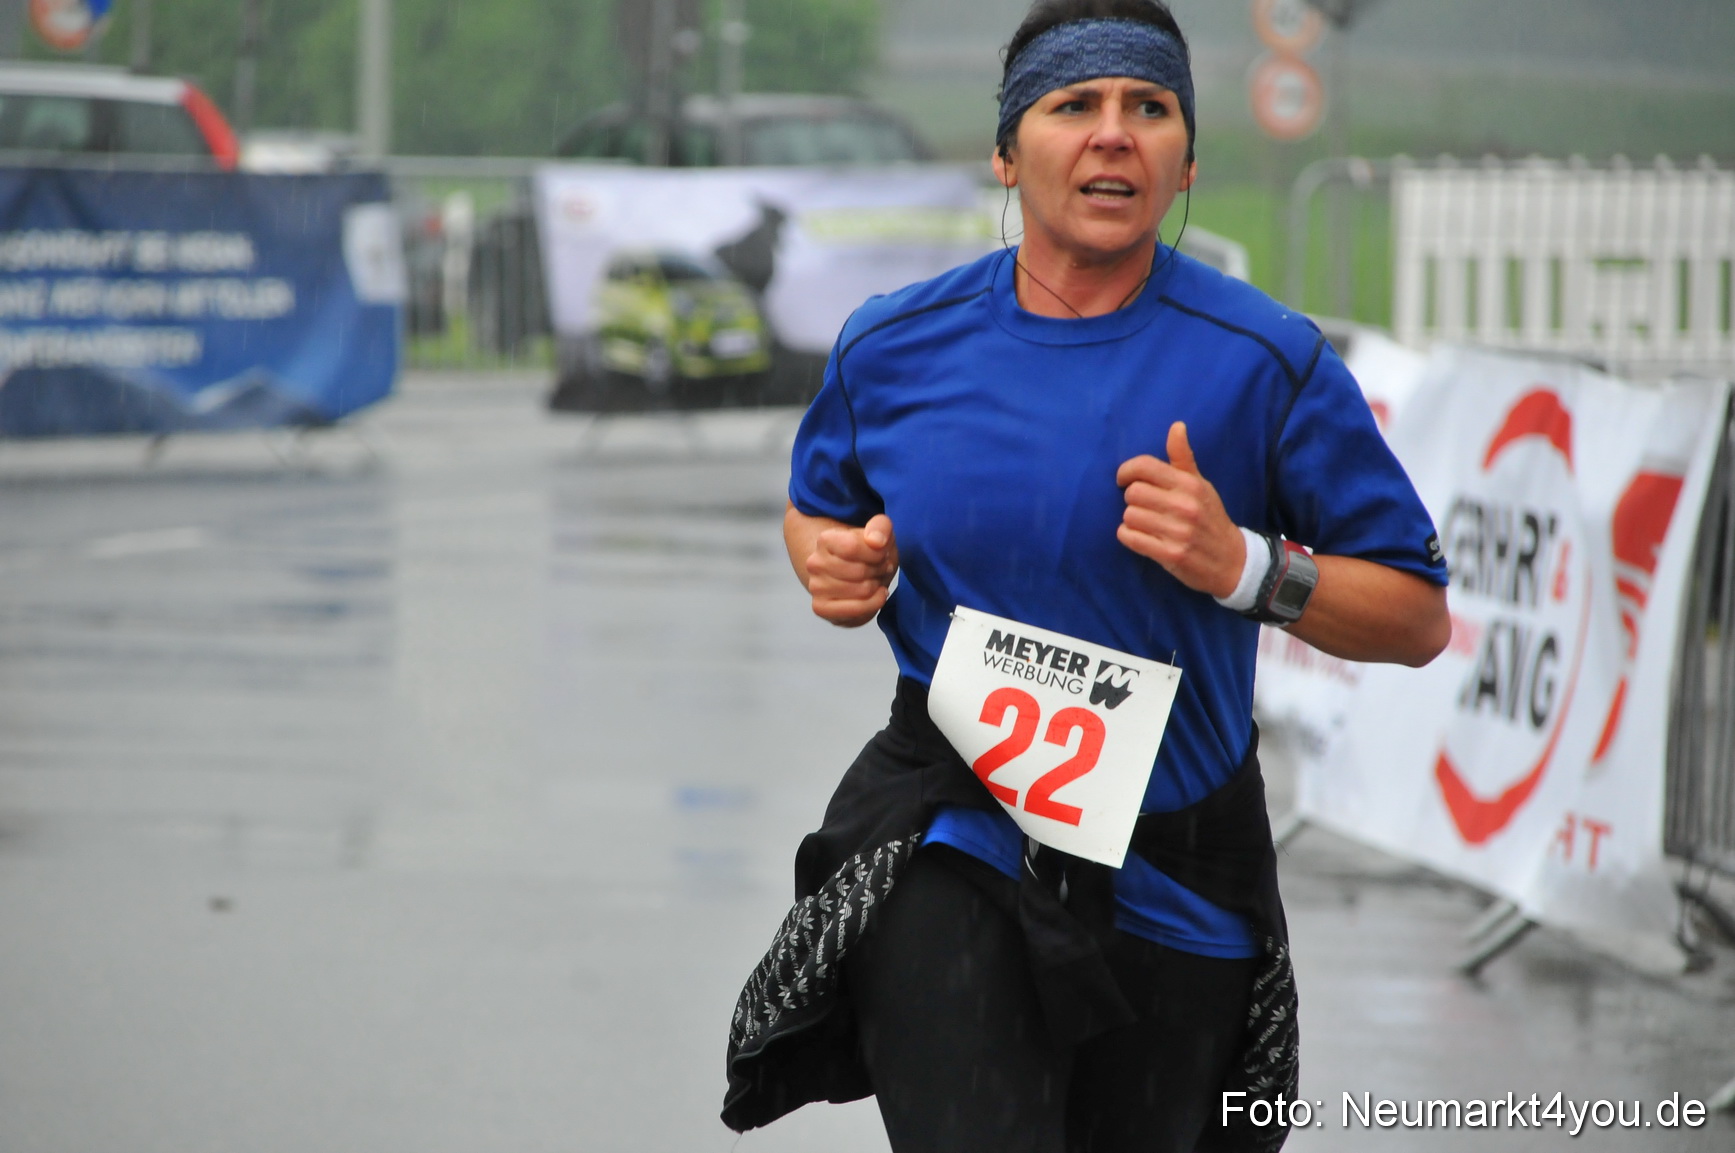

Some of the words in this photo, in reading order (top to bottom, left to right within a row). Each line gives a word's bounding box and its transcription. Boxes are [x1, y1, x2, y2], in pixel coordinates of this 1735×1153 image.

[983, 651, 1084, 695] WERBUNG
[985, 629, 1090, 678] MEYER
[972, 687, 1107, 828] 22
